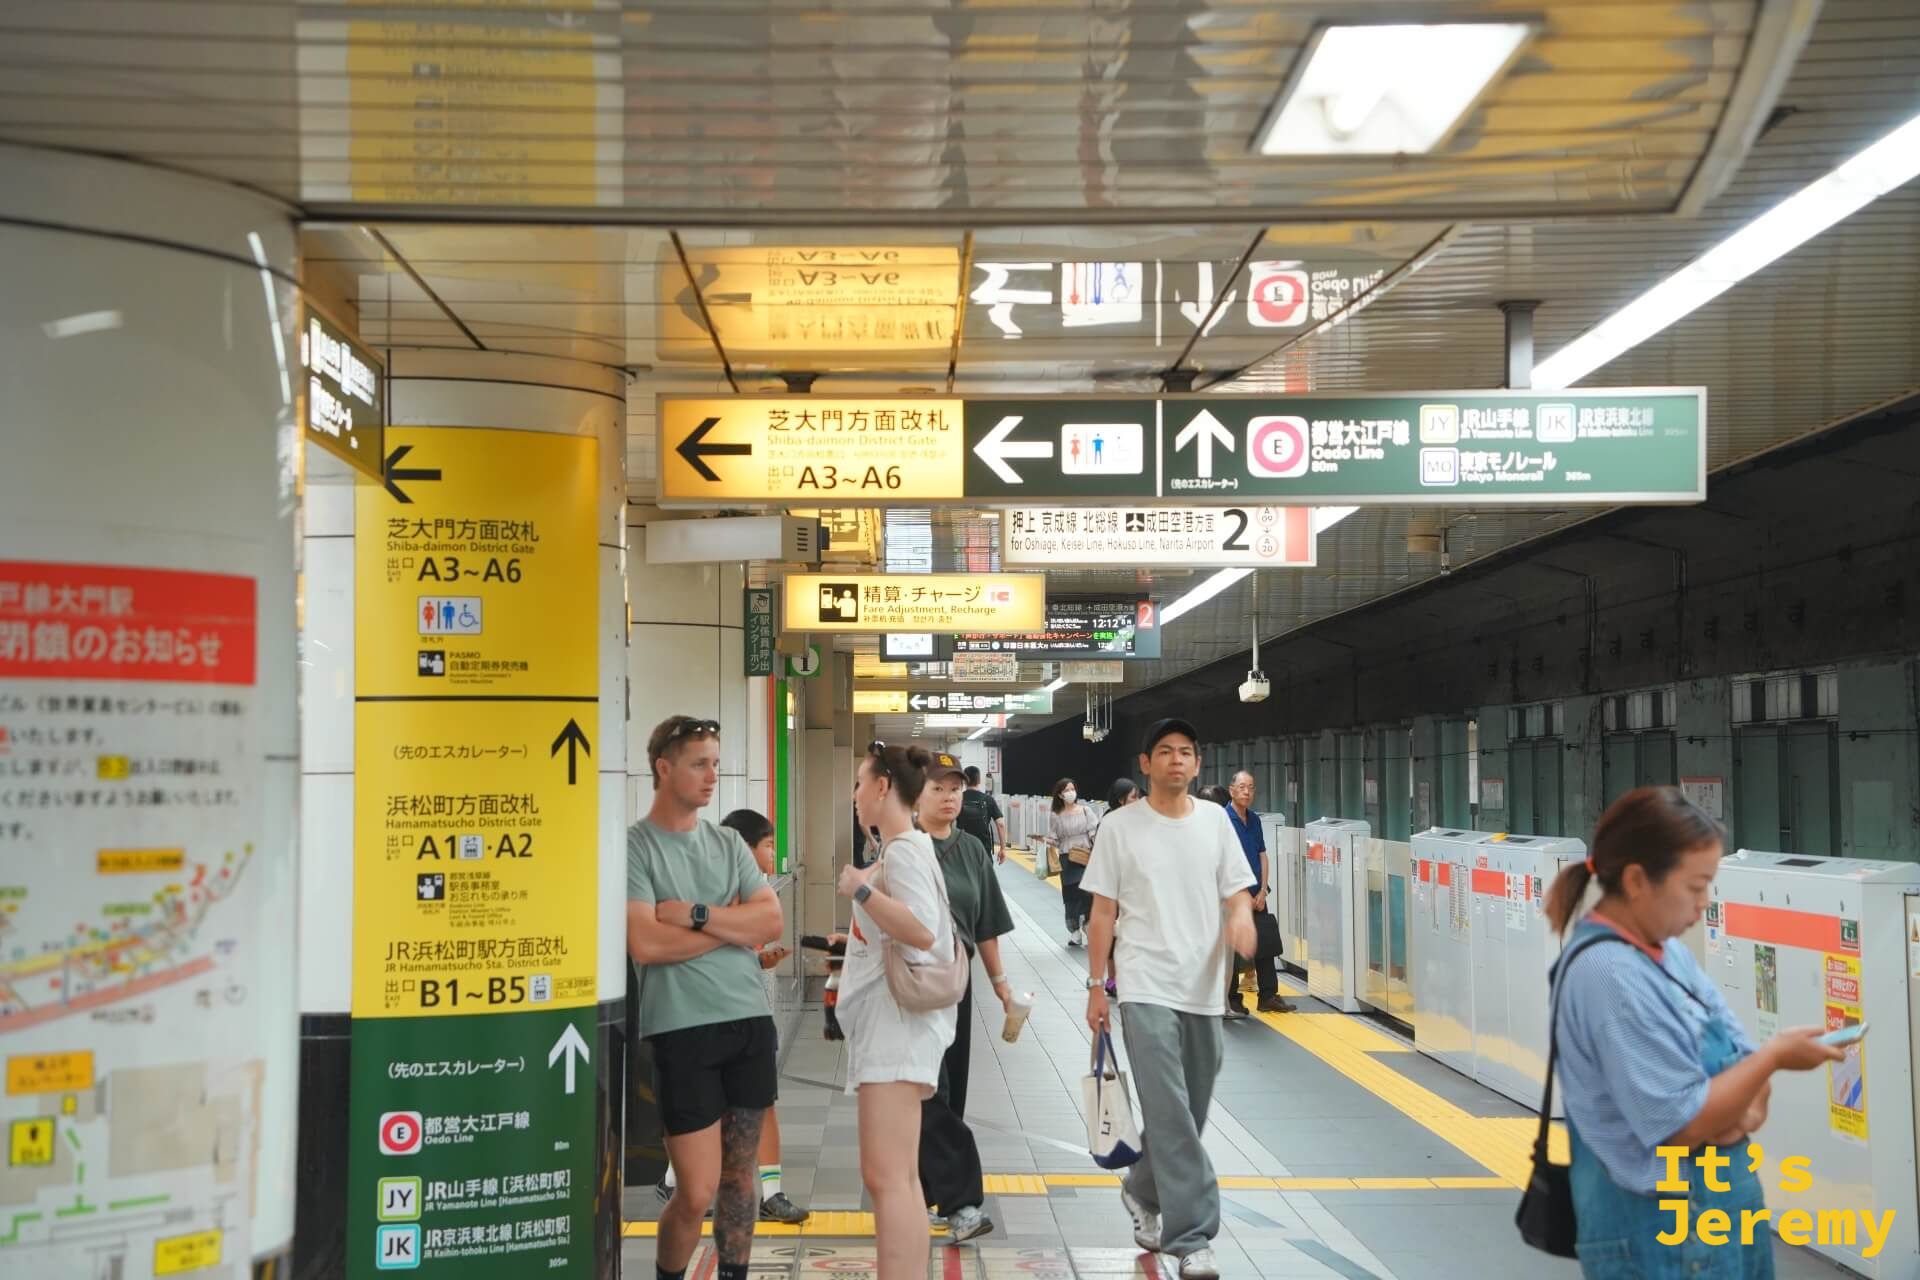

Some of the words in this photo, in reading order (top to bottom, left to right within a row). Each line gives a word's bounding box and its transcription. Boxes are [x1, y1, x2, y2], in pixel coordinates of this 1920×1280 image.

[767, 409, 950, 433] 芝大門方面改札
[1429, 415, 1450, 433] JY
[1460, 408, 1530, 430] JR山手線
[1545, 415, 1566, 432] JK
[859, 435, 903, 446] District
[907, 435, 937, 446] Gate
[1311, 420, 1410, 446] 都営大江戸線
[1272, 440, 1283, 455] E
[1311, 446, 1352, 460] Oedo
[1355, 446, 1384, 460] Line
[1426, 459, 1452, 474] MO
[1459, 450, 1557, 472] 東京モノレール
[1460, 471, 1494, 484] Tokyo
[387, 518, 539, 543] 芝大門方面改札
[1011, 510, 1036, 534] 押上
[1041, 510, 1078, 535] 京成線
[1083, 510, 1119, 534] 北総線
[1146, 511, 1215, 534] 成田空港方面
[1222, 508, 1250, 551] 2
[386, 541, 466, 552] Shiba-daimon
[470, 542, 509, 553] District
[511, 543, 535, 554] Gate
[1011, 537, 1023, 550] for
[1025, 537, 1059, 554] Oshiage,
[1061, 537, 1085, 551] Keisei
[1086, 537, 1105, 553] Line,
[1107, 537, 1137, 551] Hokuso
[1139, 537, 1157, 553] Line,
[1159, 537, 1184, 551] Narita
[1186, 537, 1215, 554] Airport
[387, 557, 414, 570] 出口
[863, 604, 885, 614] Fare
[887, 604, 947, 617] Adjustment,
[950, 604, 997, 616] Recharge
[1138, 603, 1154, 628] 2
[1092, 618, 1119, 629] 12:12
[750, 615, 760, 672] インターホン
[800, 655, 811, 673] 1
[386, 793, 540, 817] 浜松町方面改札
[386, 818, 475, 829] Hamamatsucho
[478, 817, 518, 828] District
[519, 816, 543, 827] Gate
[386, 834, 414, 848] 出口
[416, 835, 457, 860] A1
[385, 936, 568, 962] JR浜松町駅方面改札
[385, 963, 396, 973] JR
[399, 961, 482, 972] Hamamatsucho
[485, 960, 504, 970] Sta.
[507, 959, 541, 968] District
[542, 957, 562, 967] Gate
[385, 980, 415, 993] 出口
[424, 1111, 530, 1136] 都営大江戸線
[397, 1126, 405, 1140] E
[424, 1135, 451, 1145] Oedo
[453, 1133, 474, 1144] Line
[386, 1188, 413, 1209] JY
[424, 1202, 435, 1212] JR
[437, 1200, 479, 1211] Yamanote
[480, 1198, 497, 1208] Line
[384, 1236, 411, 1257] JK
[489, 1244, 505, 1255] Line
